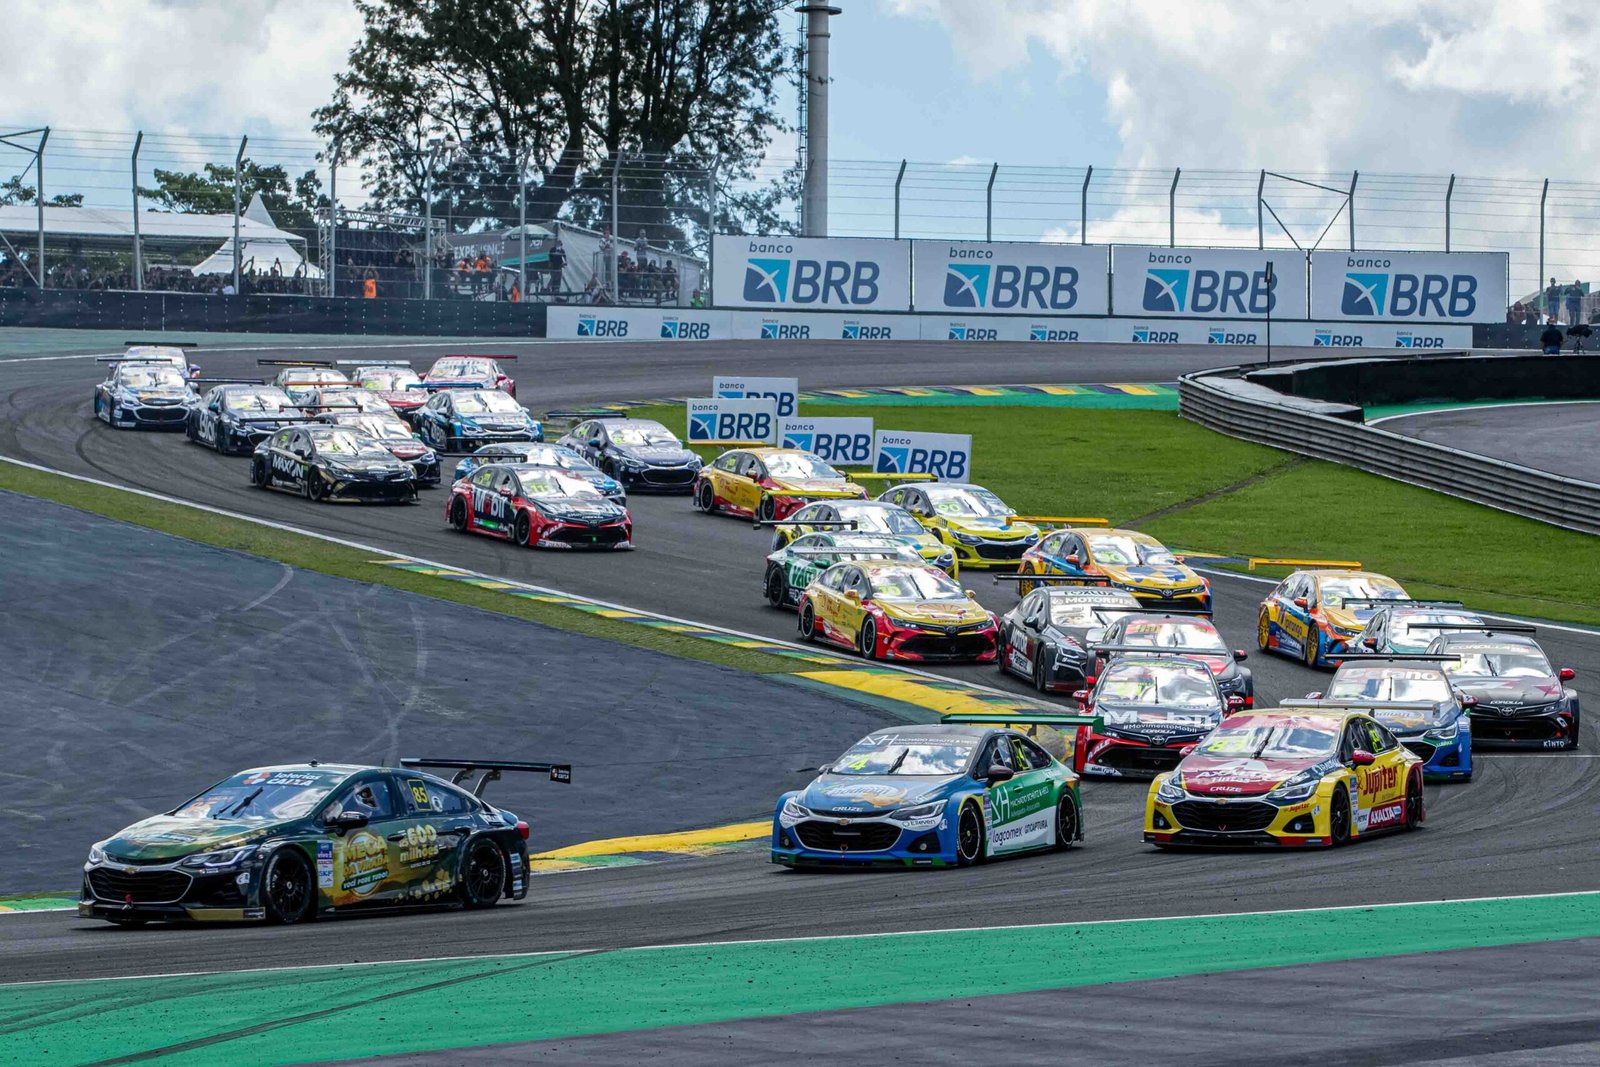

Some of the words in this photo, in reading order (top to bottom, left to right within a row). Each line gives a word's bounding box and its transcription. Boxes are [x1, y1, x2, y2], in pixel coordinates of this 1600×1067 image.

[749, 242, 793, 254] banco
[949, 247, 993, 259] banco
[1148, 251, 1192, 264] banco
[1346, 256, 1391, 268] banco
[792, 259, 880, 305] BRB
[991, 264, 1079, 310] BRB
[1190, 269, 1278, 314] BRB
[1388, 274, 1477, 318] BRB
[595, 320, 628, 337] BRB
[678, 322, 710, 339] BRB
[778, 325, 810, 339] BRB
[859, 326, 891, 339] BRB
[718, 412, 771, 439] BRB
[785, 423, 814, 431] banco
[814, 434, 871, 461] BRB
[882, 436, 912, 445] banco
[908, 448, 968, 478] BRB
[1123, 724, 1197, 733] #MovimentoMobil
[1363, 765, 1397, 803] Jupiter
[412, 787, 428, 803] 85
[1371, 807, 1395, 824] AXALTA
[407, 824, 436, 845] 600
[992, 827, 1023, 845] logcomex
[400, 844, 439, 862] milhões
